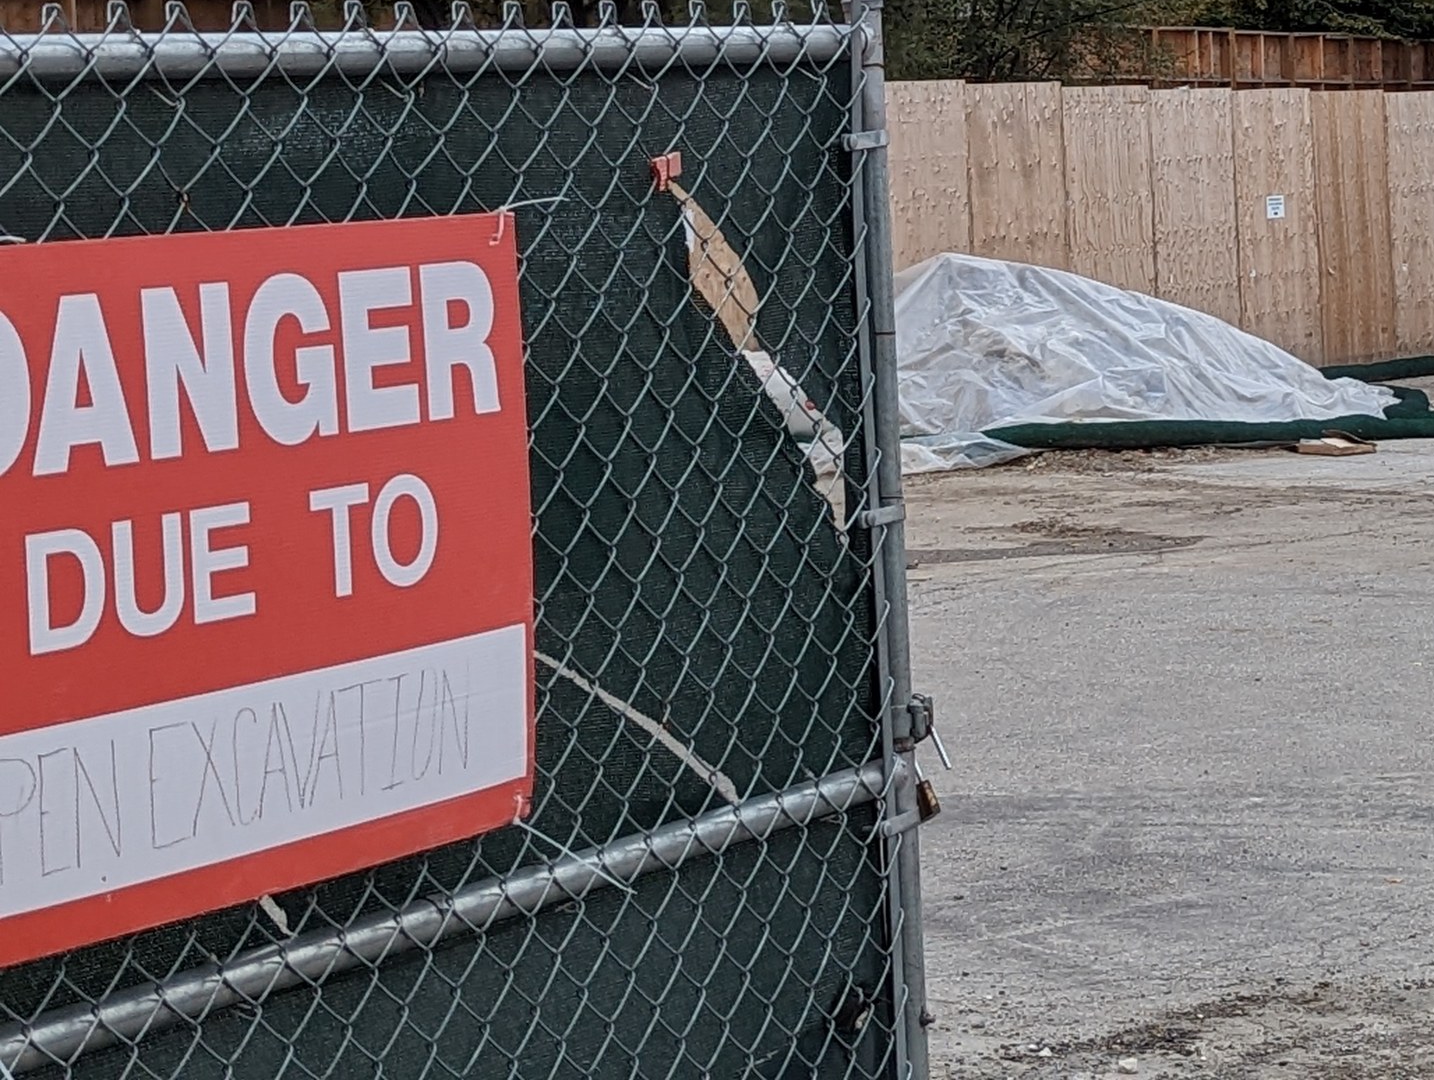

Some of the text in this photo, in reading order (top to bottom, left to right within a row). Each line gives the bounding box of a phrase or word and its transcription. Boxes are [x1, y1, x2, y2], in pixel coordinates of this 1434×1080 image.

[25, 474, 438, 655] DUE TO
[149, 658, 471, 850] EXCAVATION
